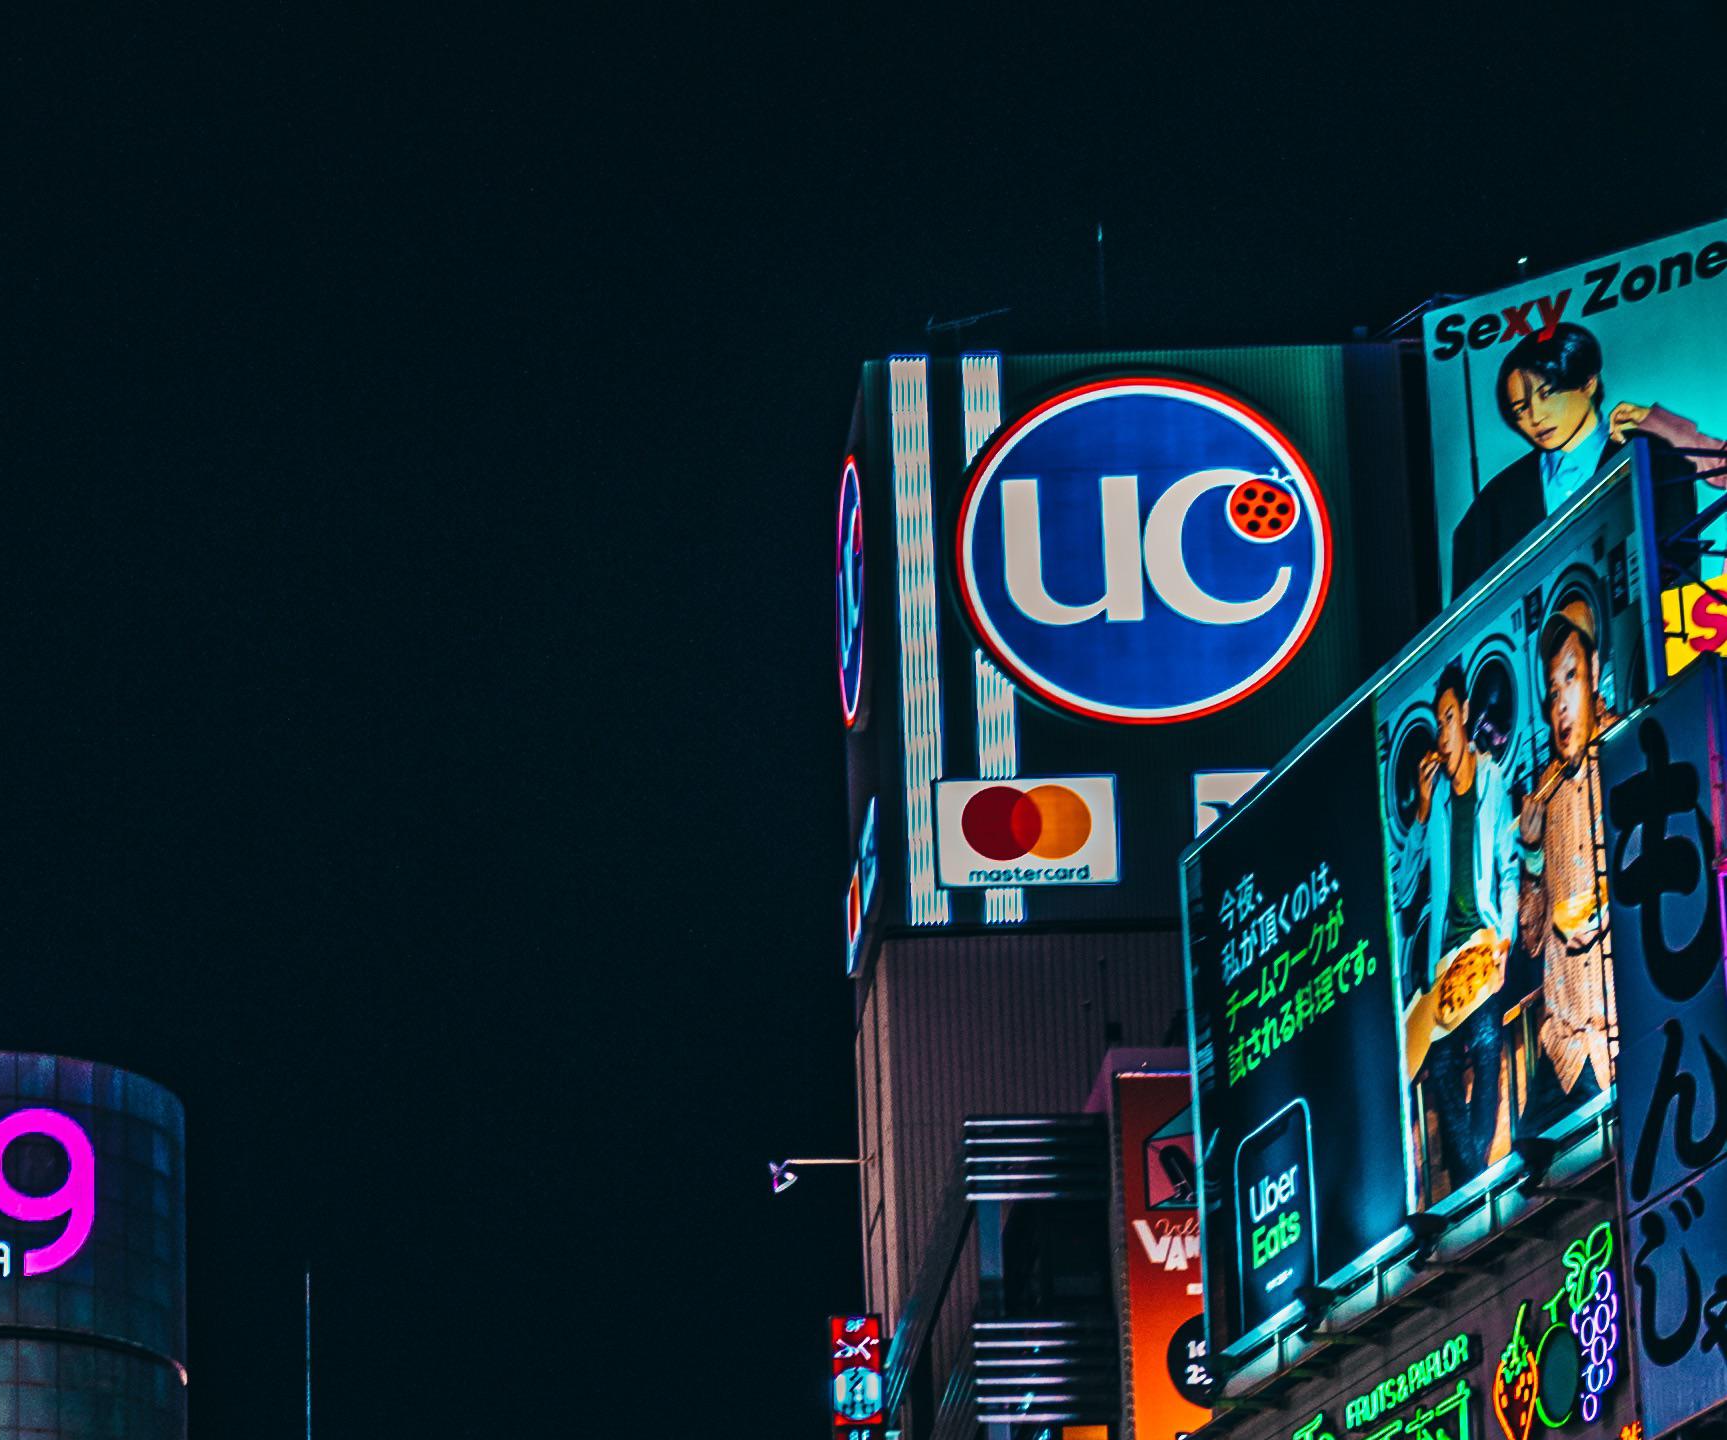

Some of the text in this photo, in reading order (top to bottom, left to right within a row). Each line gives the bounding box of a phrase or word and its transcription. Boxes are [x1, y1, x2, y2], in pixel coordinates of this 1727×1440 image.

[1432, 240, 1727, 362] Sexy Zone
[969, 863, 1091, 882] mastercard
[1218, 871, 1264, 932] 今夜、
[1220, 861, 1341, 986] 私が頂くのは、
[1225, 897, 1345, 1034] チームワークが
[1228, 938, 1377, 1088] 試される料理です。
[1248, 1164, 1299, 1225] Uber
[1251, 1210, 1302, 1271] Eats
